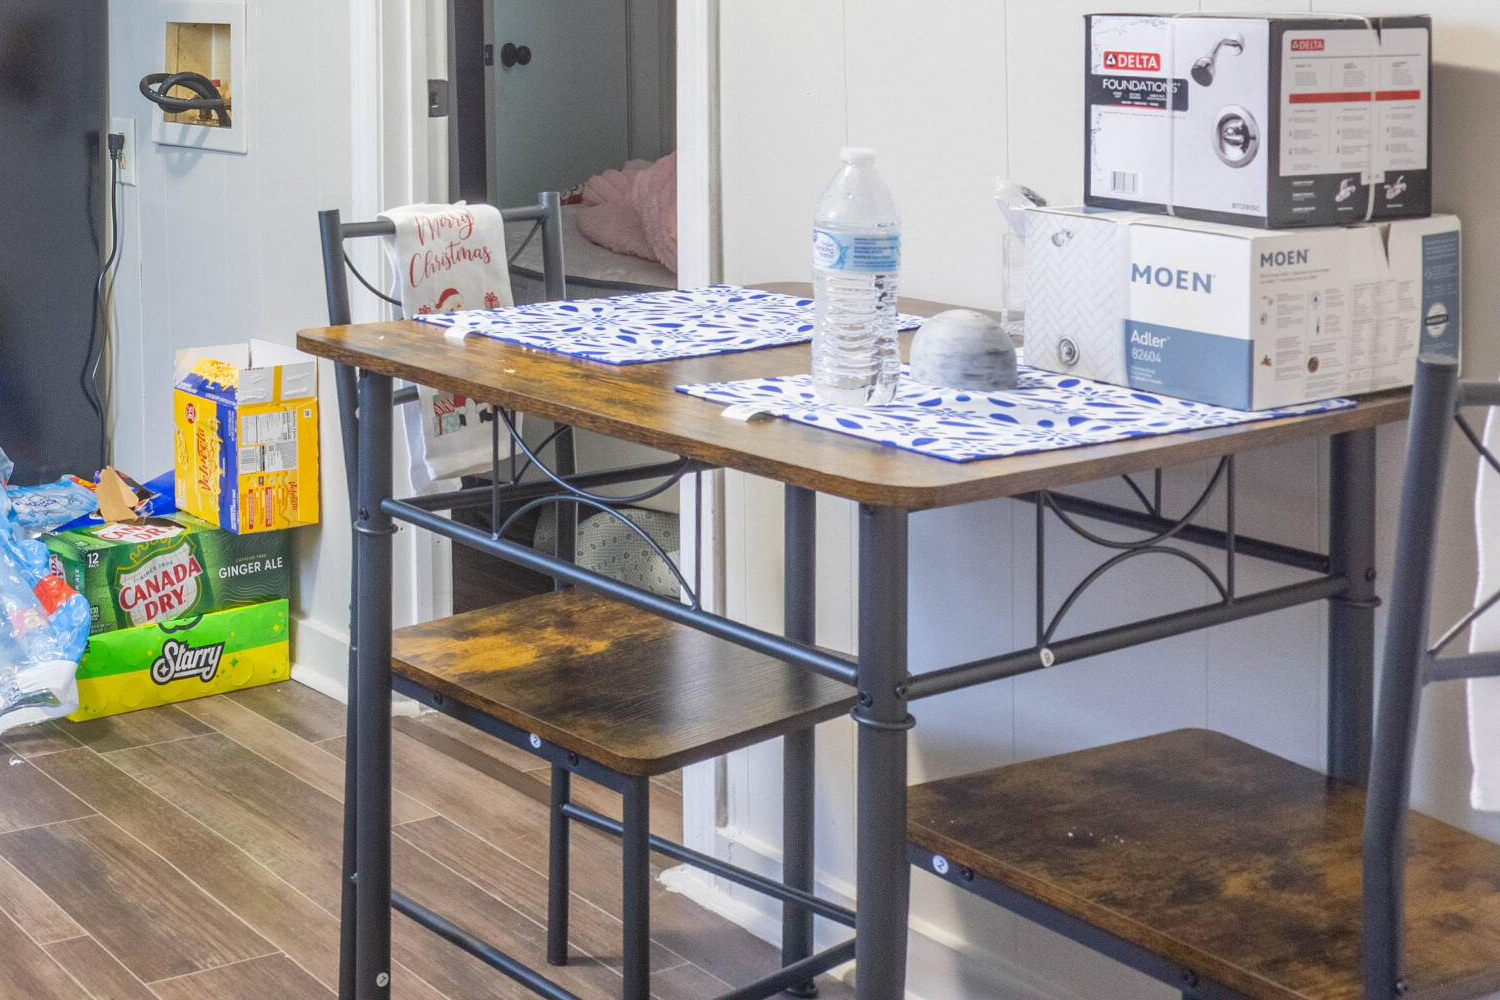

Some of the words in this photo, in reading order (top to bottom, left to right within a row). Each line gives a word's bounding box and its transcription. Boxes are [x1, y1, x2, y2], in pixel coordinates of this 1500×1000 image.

[1300, 40, 1323, 50] DELTA
[1118, 54, 1158, 69] DELTA
[414, 213, 475, 246] Merry
[409, 241, 492, 288] Christmas
[1260, 249, 1308, 268] MOEN
[1131, 263, 1212, 294] MOEN
[1130, 330, 1167, 348] Adler
[1131, 348, 1162, 364] 82604
[197, 427, 211, 492] Velveeta
[87, 552, 100, 564] 12
[219, 562, 262, 579] GINGER
[264, 556, 284, 571] ALE
[119, 555, 203, 611] CANADA
[144, 584, 184, 622] DRY
[152, 640, 224, 684] Starry
